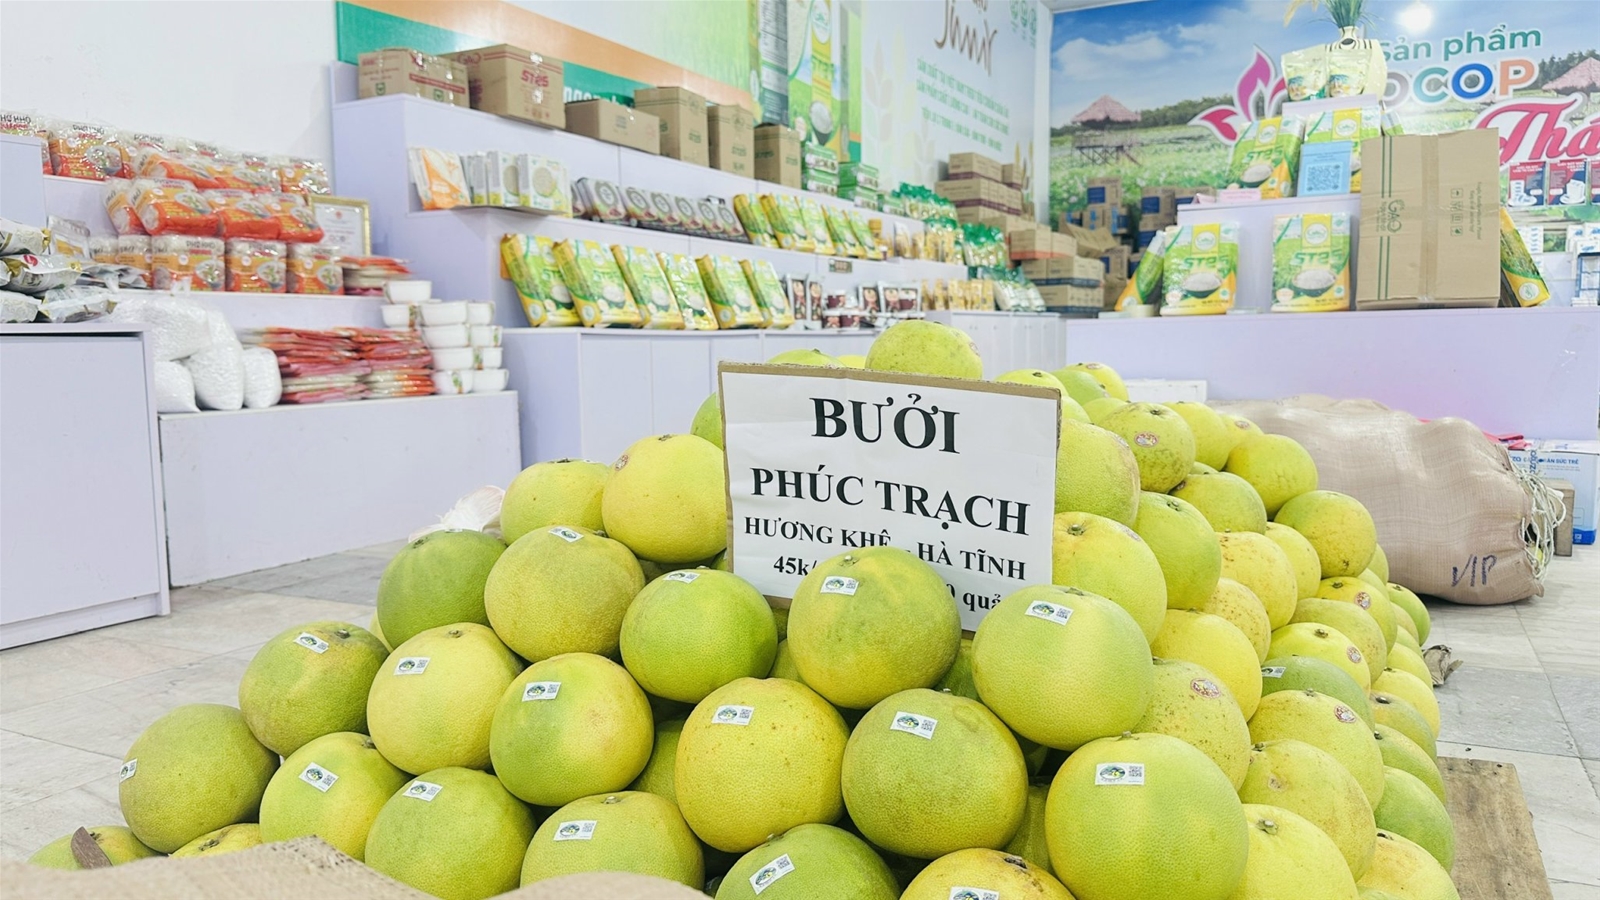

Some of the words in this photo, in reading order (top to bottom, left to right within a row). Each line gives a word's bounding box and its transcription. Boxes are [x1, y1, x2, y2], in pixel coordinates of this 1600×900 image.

[1443, 24, 1541, 61] phẩm
[809, 393, 960, 454] BƯỞI
[750, 465, 864, 506] PHÚC
[873, 480, 1031, 536] TRẠCH
[744, 516, 835, 545] HƯƠNG
[840, 529, 892, 549] KHÊ
[917, 541, 953, 566] HÀ
[959, 549, 1027, 581] TĨNH
[1451, 554, 1498, 587] VIP
